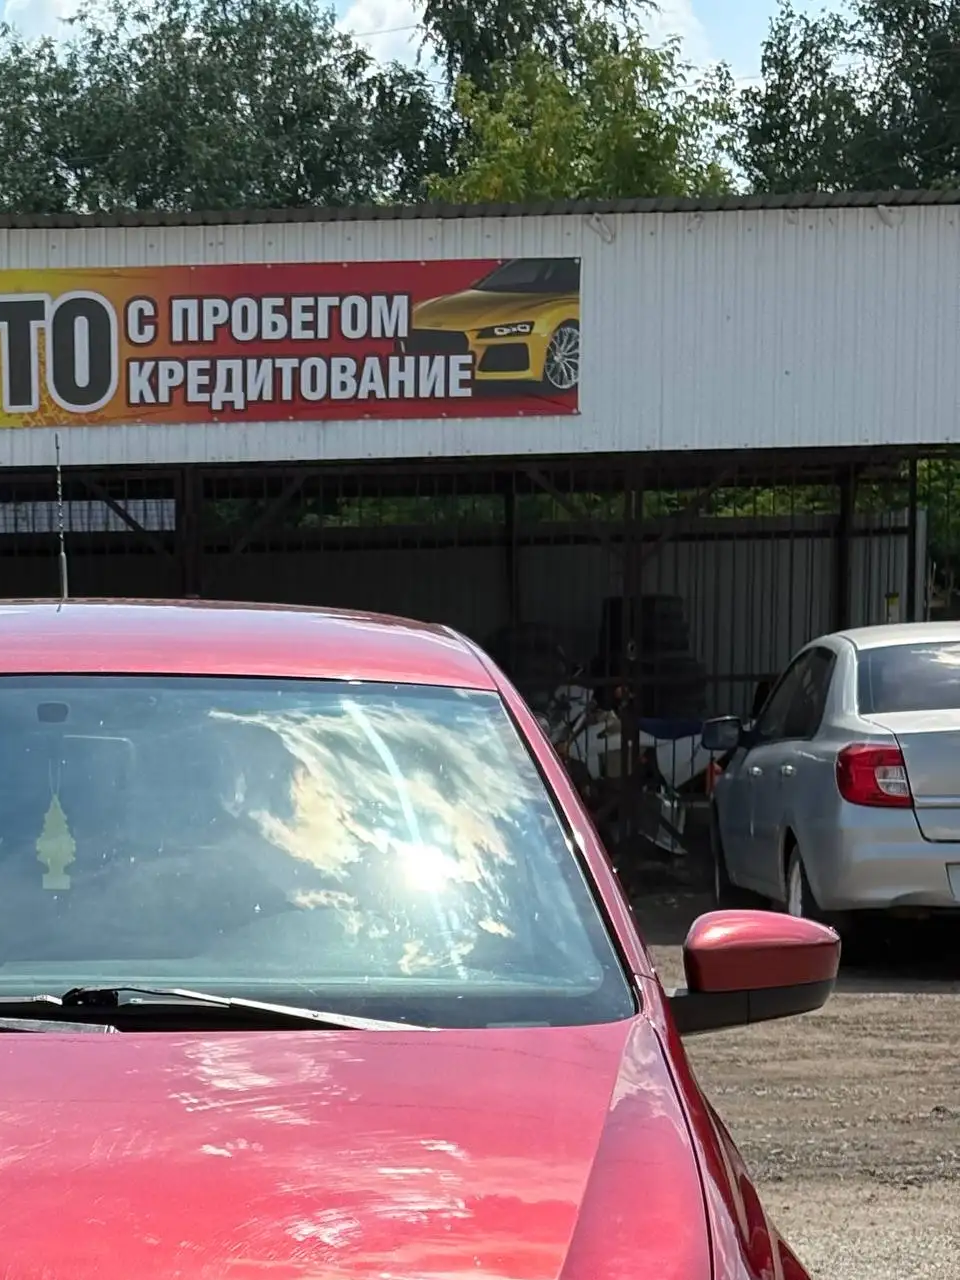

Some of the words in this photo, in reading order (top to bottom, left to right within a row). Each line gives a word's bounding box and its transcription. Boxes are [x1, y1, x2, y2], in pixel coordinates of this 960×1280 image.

[126, 297, 156, 344] С
[171, 293, 409, 342] ПРОБЕГОМ
[128, 354, 473, 411] КРЕДИТОВАНИЕ
